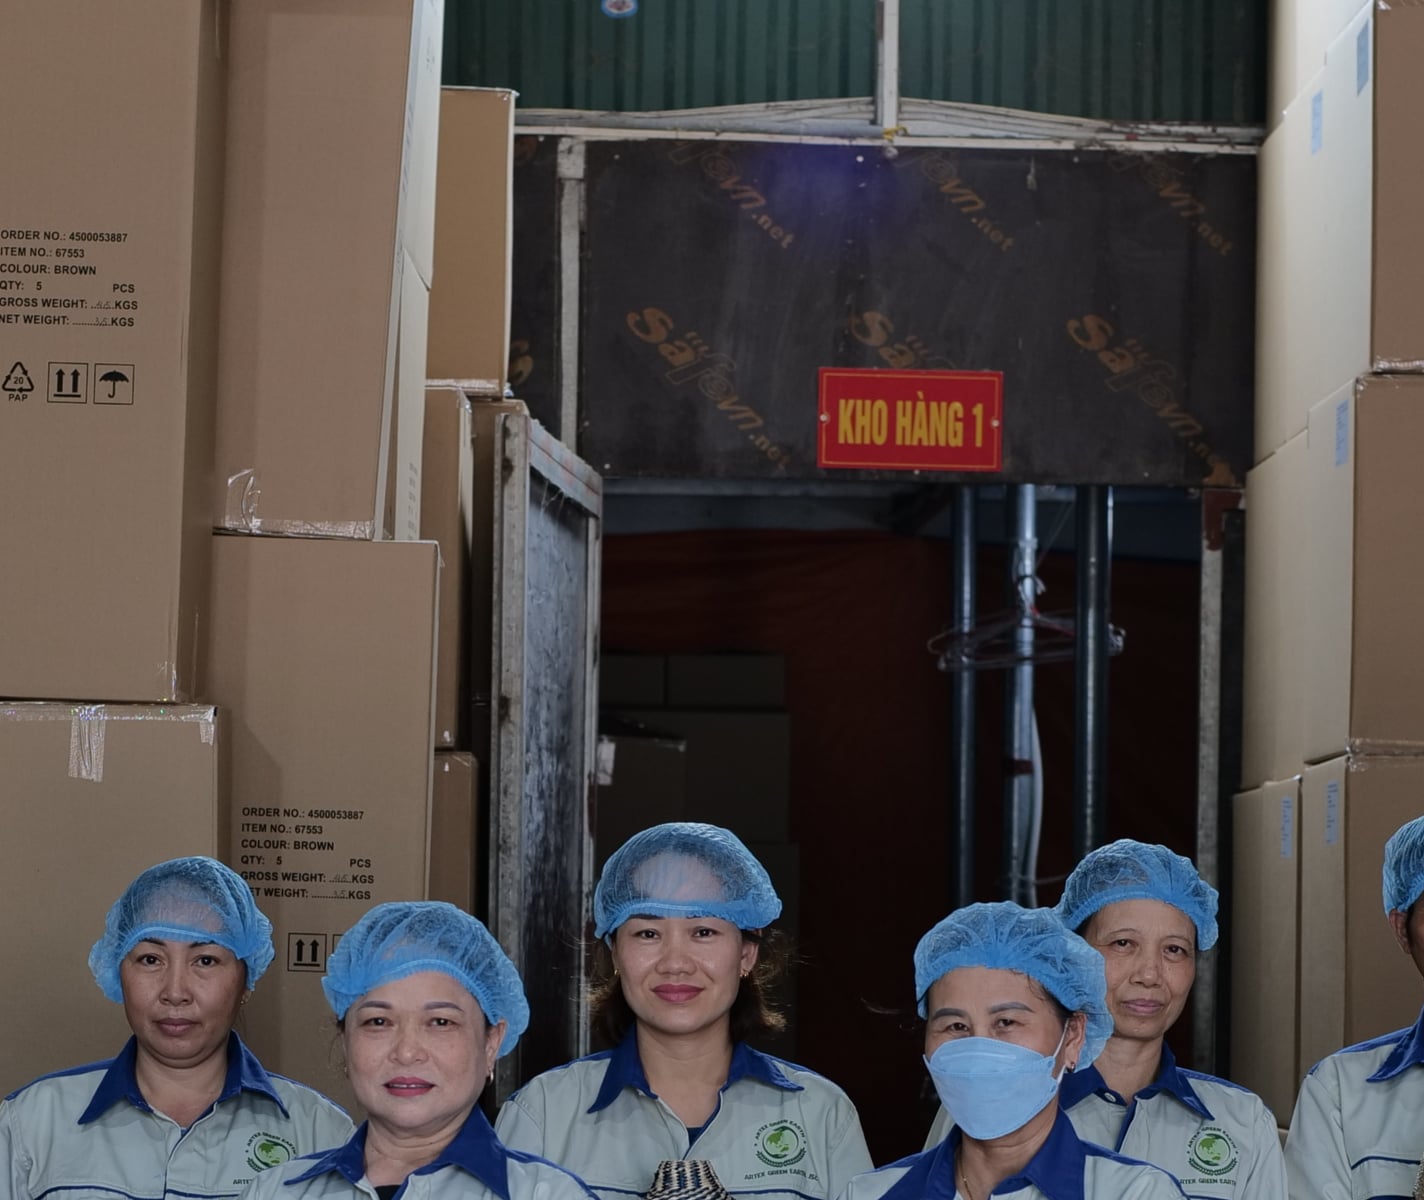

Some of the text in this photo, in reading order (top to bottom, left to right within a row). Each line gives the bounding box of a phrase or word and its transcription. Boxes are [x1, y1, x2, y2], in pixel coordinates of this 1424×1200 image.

[1, 230, 128, 242] ORDER NO.: 4500053887
[0, 247, 85, 258] ITEM NO.: 67553
[0, 264, 96, 275] COLOUR: BROWN
[0, 280, 135, 293] QTY: 5 PCS
[0, 297, 38, 307] GROSS
[41, 299, 88, 308] WEIGHT:
[23, 315, 69, 325] WEIGHT:
[8, 394, 28, 402] PAP
[838, 391, 983, 448] KHO HÀNG 1
[242, 807, 364, 820] ORDER NO.: 4500053887
[241, 823, 323, 834] ITEM NO.: 67553
[241, 839, 334, 851] COLOUR: BROWN
[240, 855, 371, 868] QTY: 5 PCS
[240, 871, 278, 881] GROSS
[282, 872, 326, 882] WEIGHT:
[264, 888, 309, 898] WEIGHT:
